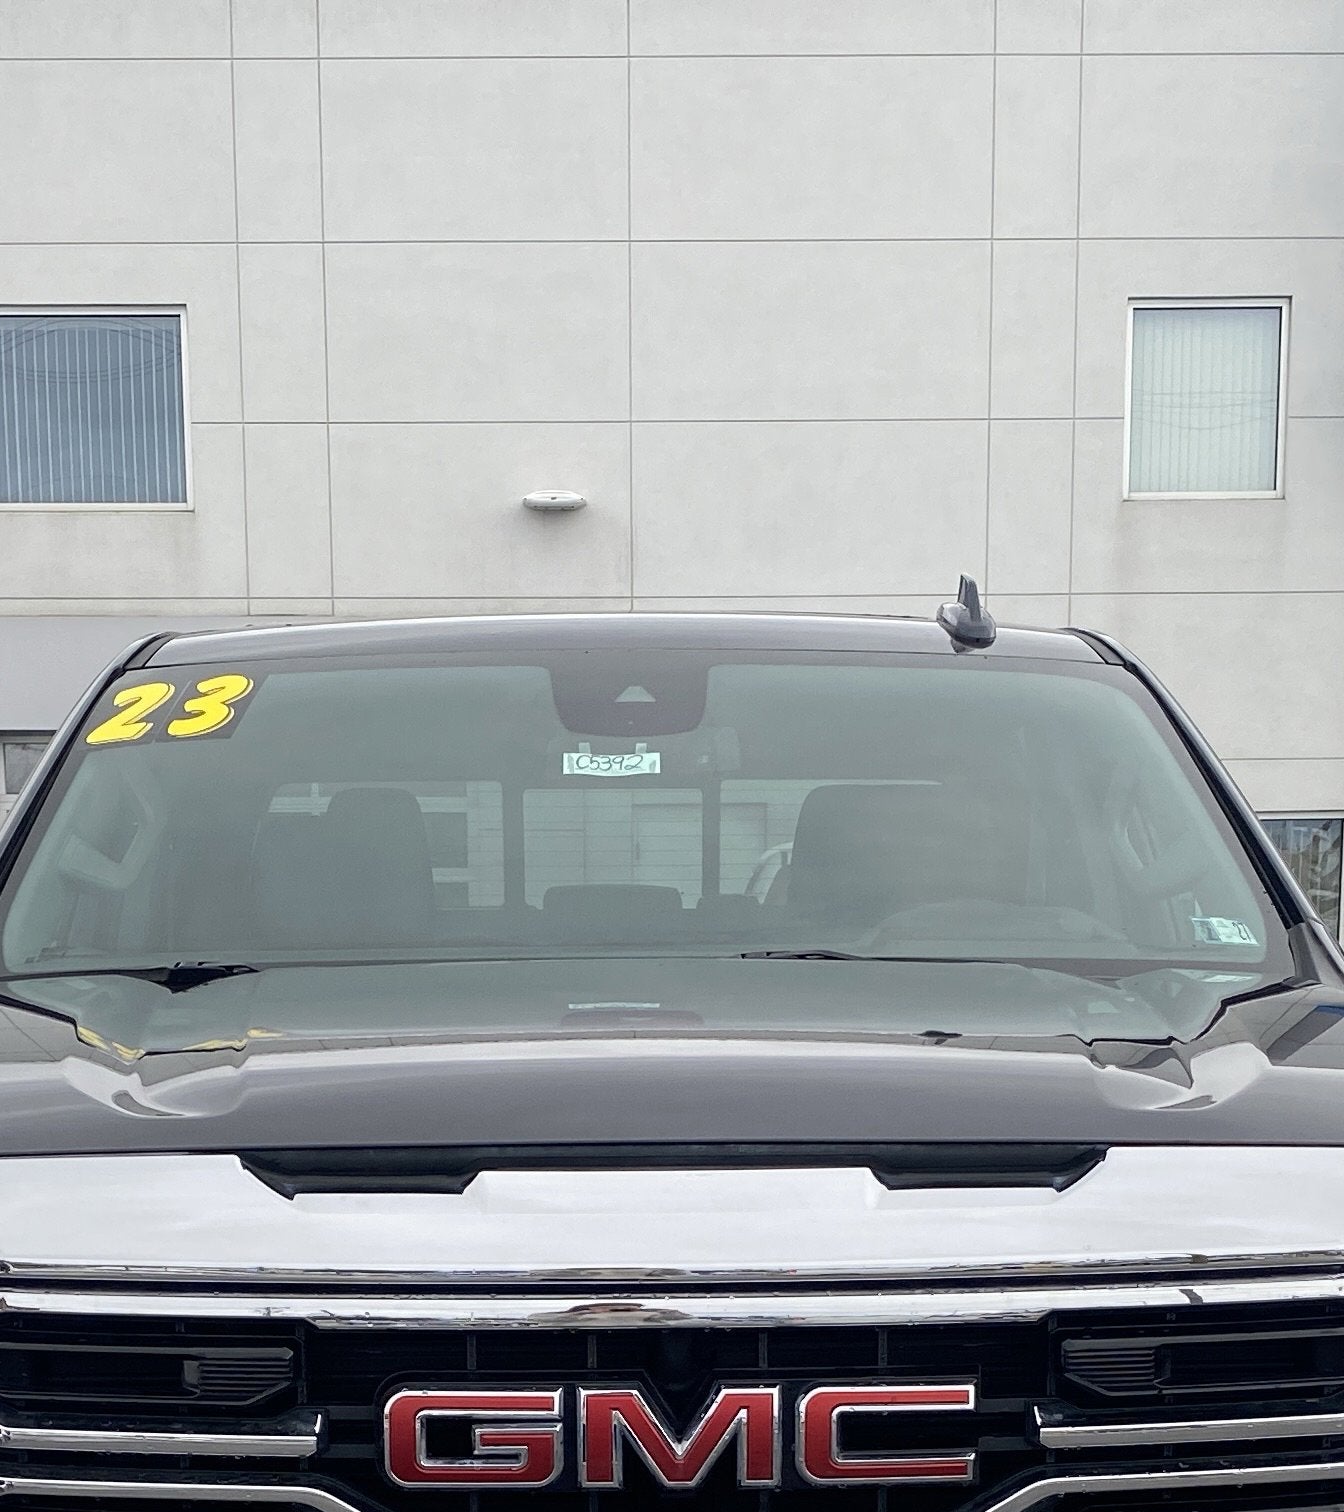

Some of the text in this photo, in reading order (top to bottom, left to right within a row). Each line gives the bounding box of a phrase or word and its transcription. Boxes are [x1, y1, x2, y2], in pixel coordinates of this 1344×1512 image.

[86, 674, 254, 744] 23
[576, 754, 644, 771] C5392
[384, 1385, 976, 1488] GMC
